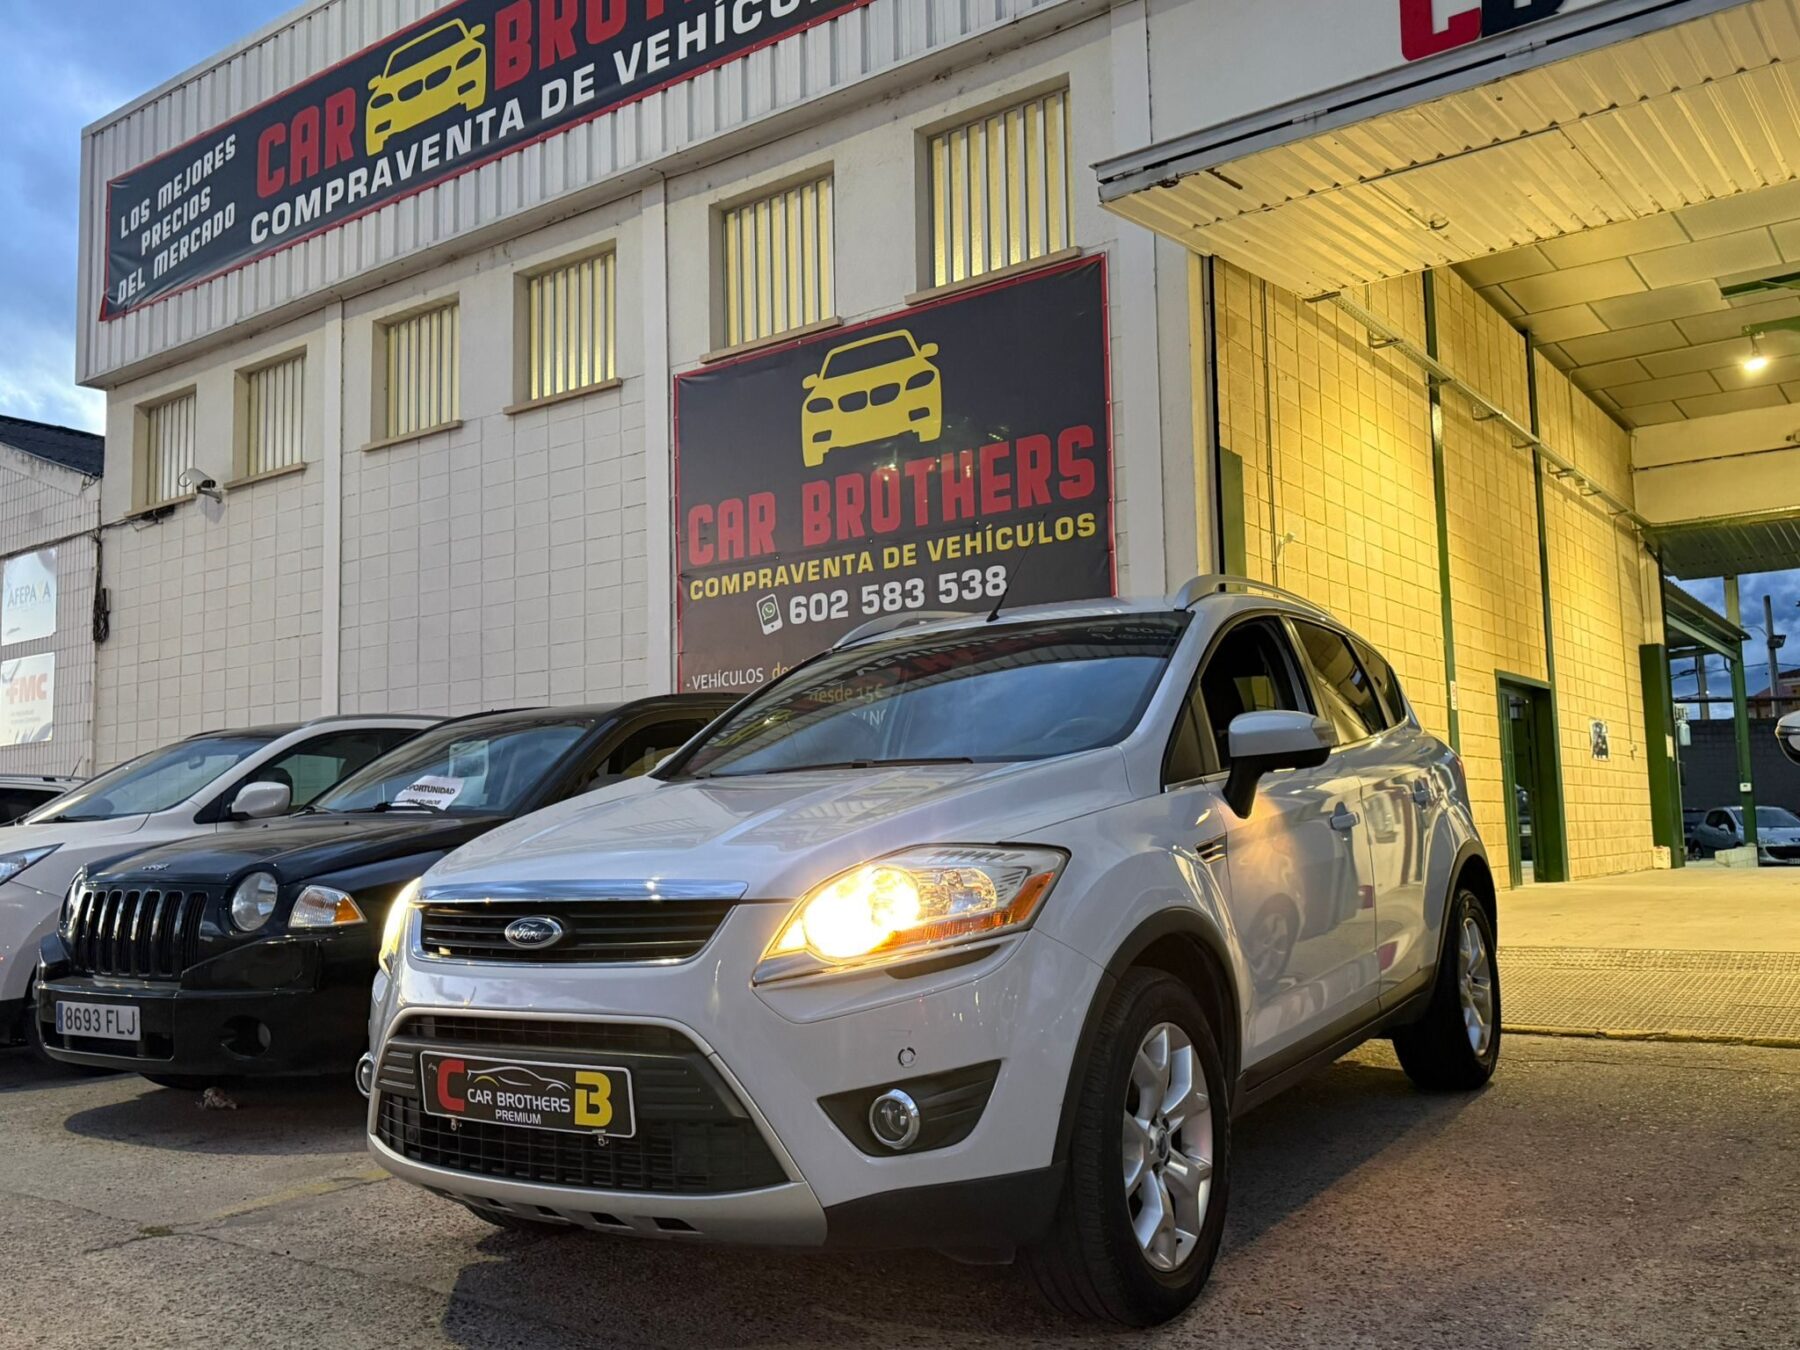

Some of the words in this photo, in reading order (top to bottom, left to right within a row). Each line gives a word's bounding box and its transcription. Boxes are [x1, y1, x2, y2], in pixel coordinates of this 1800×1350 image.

[250, 98, 525, 244] COMPRAVENTA
[541, 63, 596, 120] DE
[257, 86, 356, 199] CAR
[120, 198, 151, 239] LOS
[157, 134, 237, 209] MEJORES
[117, 267, 146, 305] DEL
[153, 202, 236, 278] MERCADO
[141, 186, 211, 256] PRECIOS
[687, 491, 778, 566] CAR
[801, 424, 1096, 547] BROTHERS
[689, 545, 874, 601] COMPRAVENTA
[882, 541, 918, 570] DE
[926, 512, 1097, 561] VEHÍCULOS
[7, 581, 52, 608] AFEPAA
[788, 589, 849, 625] 602
[861, 577, 926, 616] 583
[938, 565, 1009, 603] 538
[6, 673, 48, 704] FMC
[692, 667, 764, 690] VEHÍCULOS
[65, 1006, 101, 1033] 8693
[106, 1008, 137, 1036] FLJ
[467, 1088, 493, 1105] CAR
[496, 1092, 571, 1113] BROTHERS
[495, 1109, 542, 1125] PREMIUM
